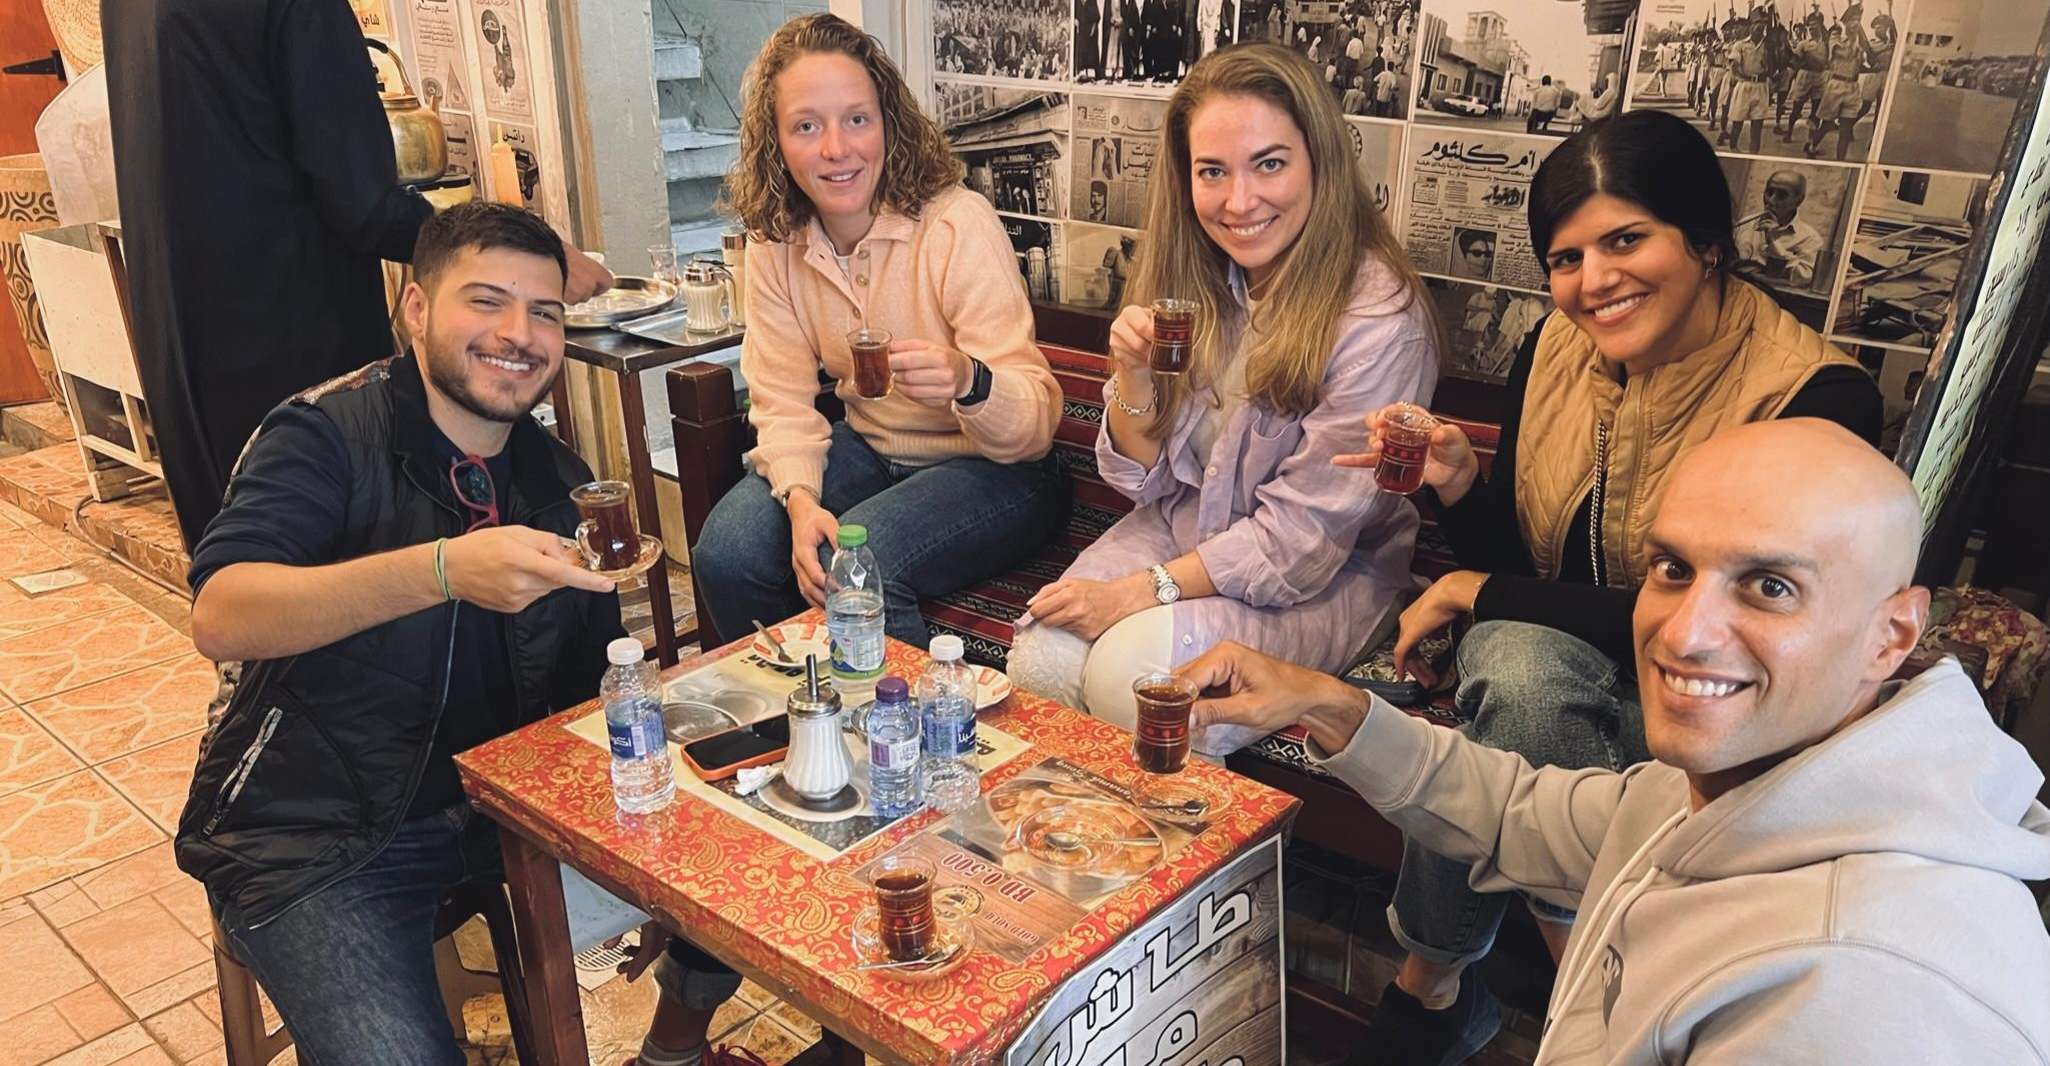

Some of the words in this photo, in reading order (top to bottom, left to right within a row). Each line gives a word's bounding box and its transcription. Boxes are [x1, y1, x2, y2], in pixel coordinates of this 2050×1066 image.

[1422, 140, 1509, 165] كلثوم
[942, 853, 1004, 886] 0.500
[999, 881, 1036, 903] BD
